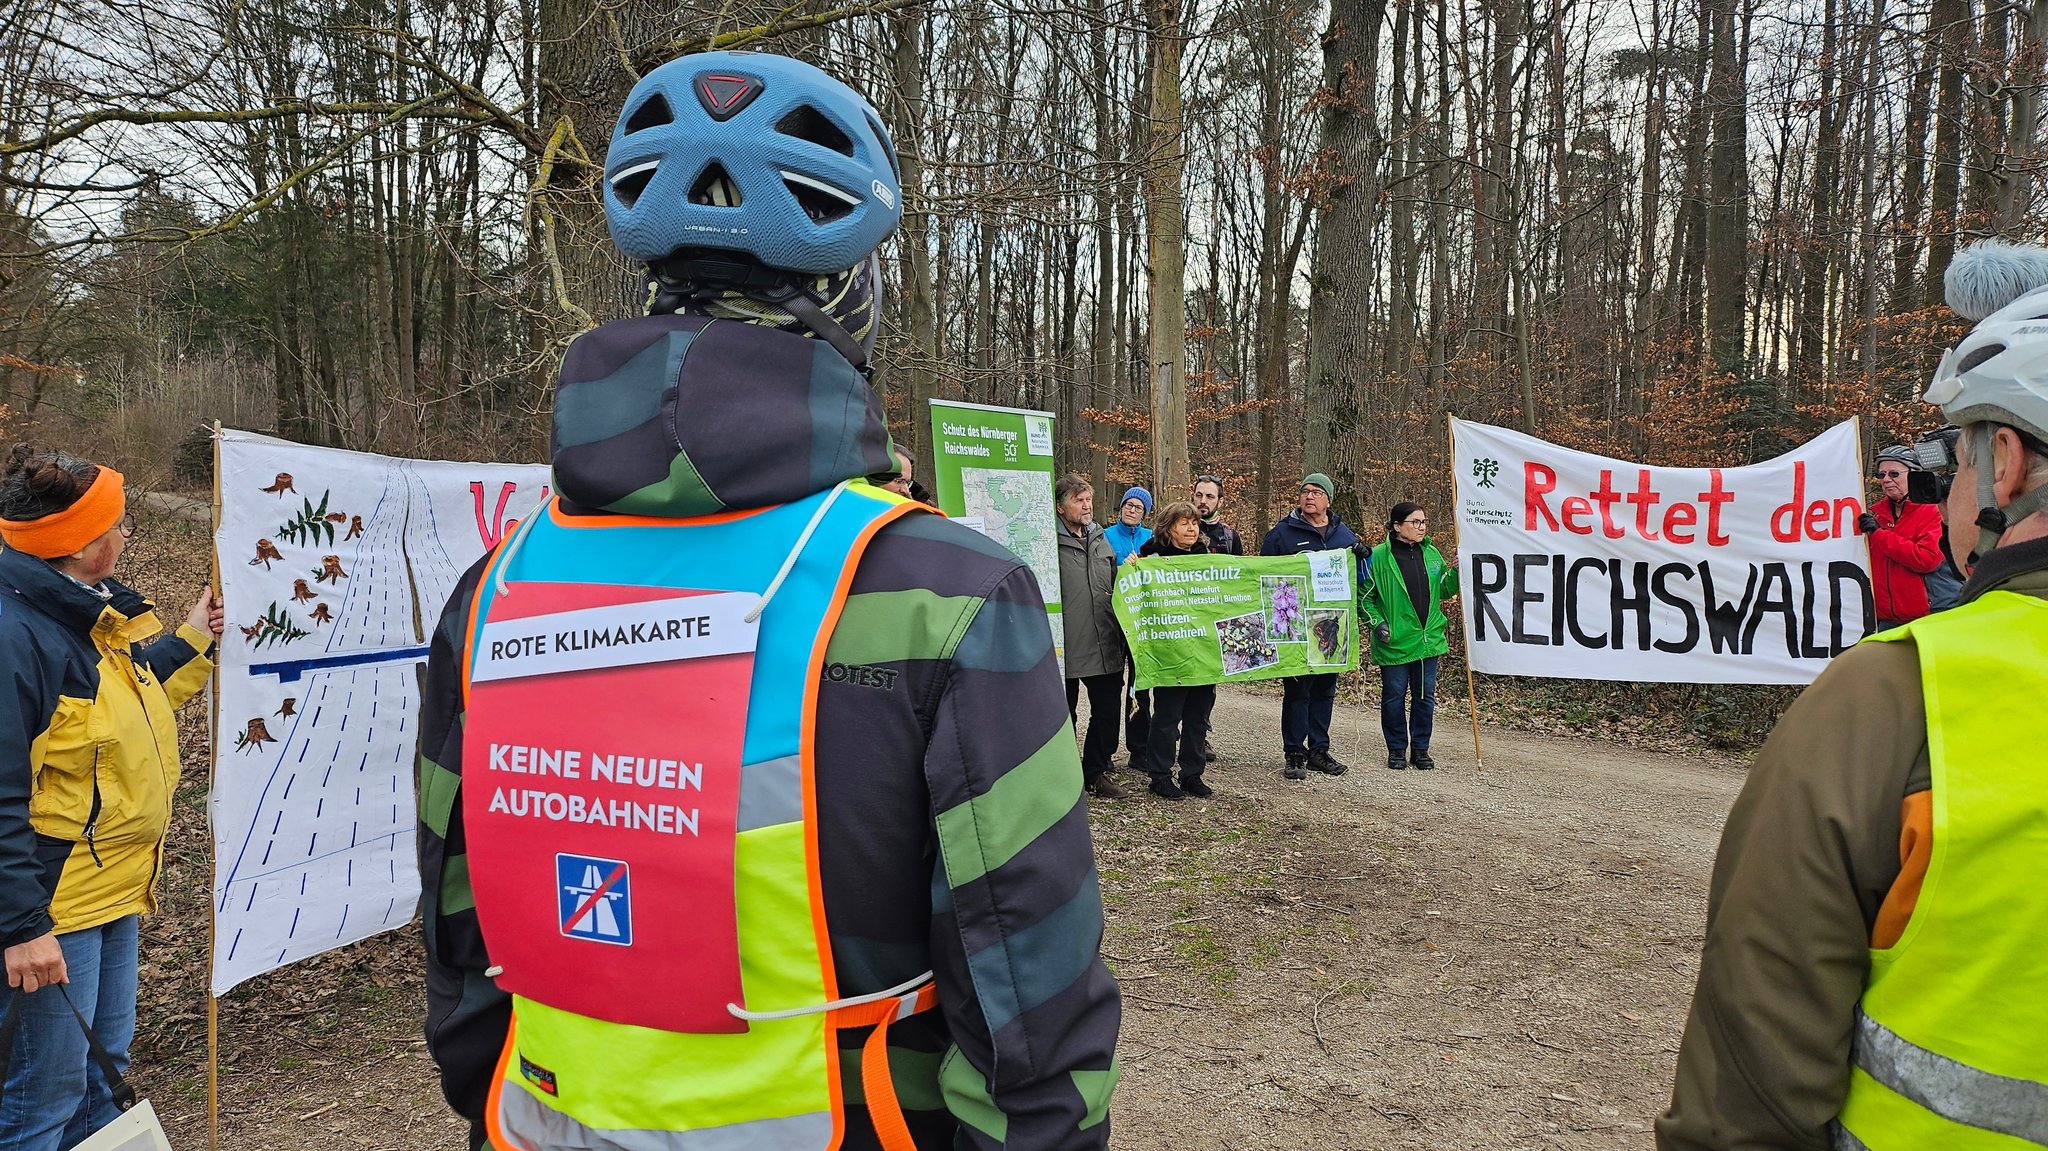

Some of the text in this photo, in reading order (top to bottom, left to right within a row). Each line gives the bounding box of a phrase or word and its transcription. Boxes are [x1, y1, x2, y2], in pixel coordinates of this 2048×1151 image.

[942, 422, 1018, 443] Schutz des Nürnberger
[944, 441, 990, 457] Reichswaldes
[1466, 508, 1512, 517] Naturschutz
[1524, 461, 1863, 547] Rettet den
[1474, 517, 1499, 525] Bayern
[1155, 565, 1241, 584] Naturschutz
[1152, 587, 1185, 597] Fischbach
[1190, 585, 1220, 595] Altenfurt
[1164, 598, 1184, 607] Brunn
[1188, 596, 1219, 606] Netzstall
[1224, 593, 1251, 603] Birnthon
[1471, 554, 1877, 658] REICHSWALD
[491, 615, 711, 661] ROTE KLIMAKARTE
[1151, 626, 1207, 640] bewahren!
[489, 743, 703, 792] KEINE NEUEN
[488, 785, 699, 838] AUTOBAHNEN
